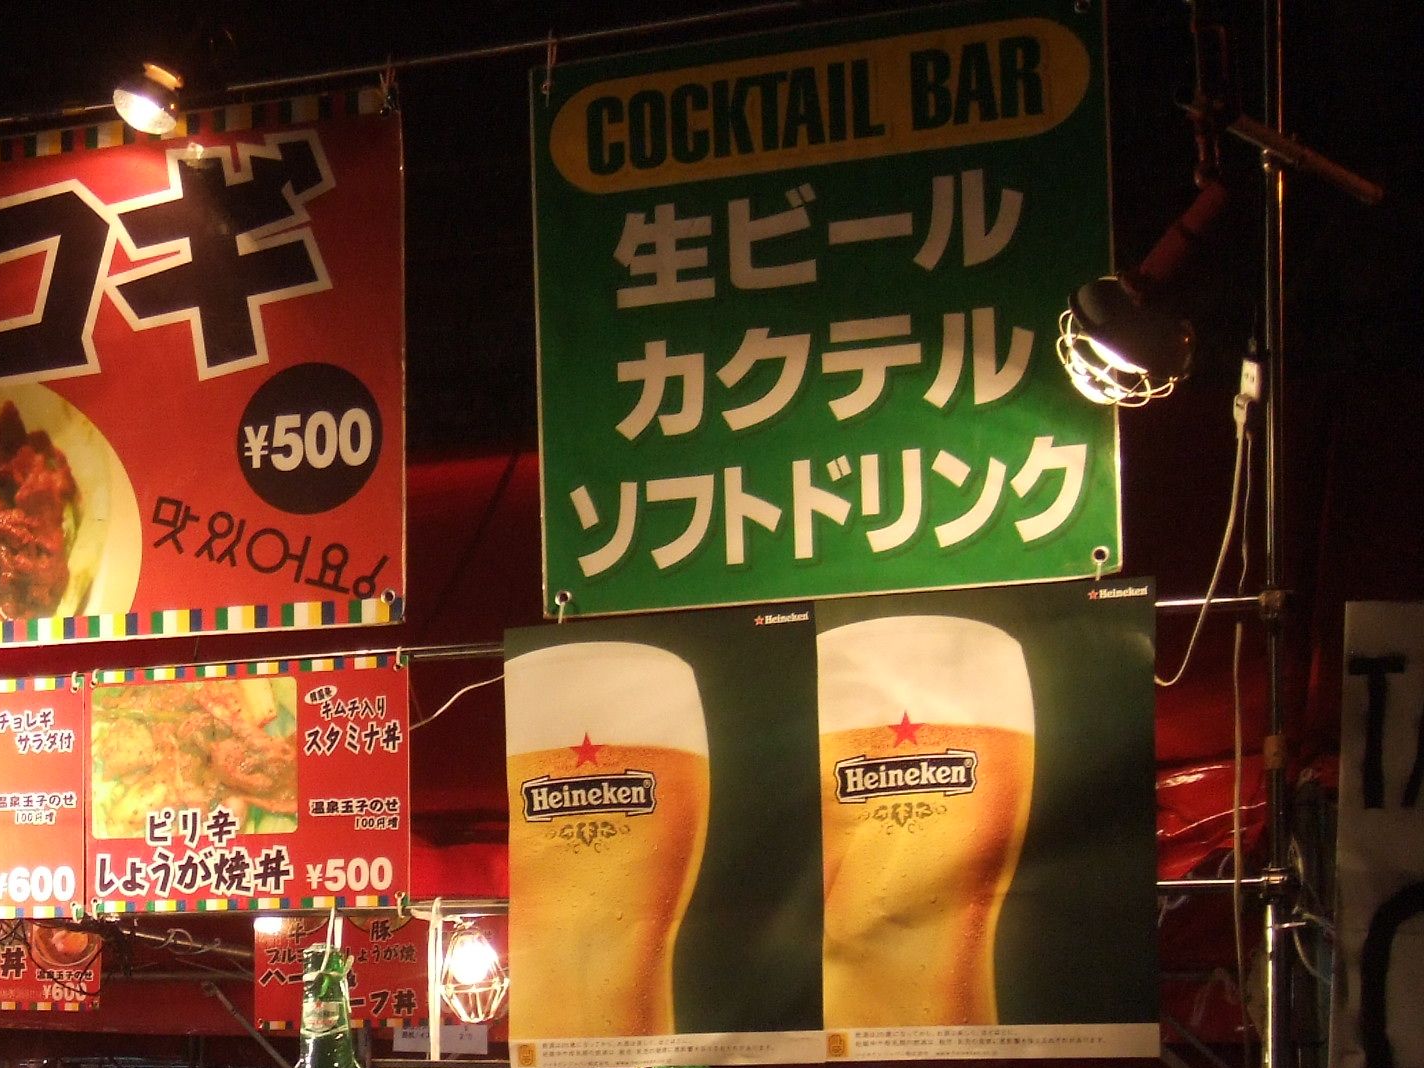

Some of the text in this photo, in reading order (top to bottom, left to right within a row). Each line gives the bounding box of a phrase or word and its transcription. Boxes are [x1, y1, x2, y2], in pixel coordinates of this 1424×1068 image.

[586, 35, 1044, 176] COCKTAIL BAR
[613, 169, 1024, 309] 生ビール
[615, 307, 1035, 440] カクテル
[243, 408, 373, 471] ¥500
[570, 436, 1088, 577] ソフトドリンク
[1099, 586, 1148, 599] Heineken
[764, 611, 810, 624] Heineken
[320, 698, 386, 719] キムチ入り
[17, 732, 73, 751] サラダ付
[306, 721, 401, 753] スタミナ丼
[844, 760, 969, 792] Heineken
[311, 799, 399, 814] 温泉玉子のせ
[531, 781, 648, 813] Heineken
[148, 810, 237, 844] ピリ辛
[98, 850, 291, 894] しょうが焼丼
[306, 857, 394, 892] ¥500
[43, 982, 87, 1001] ¥600
